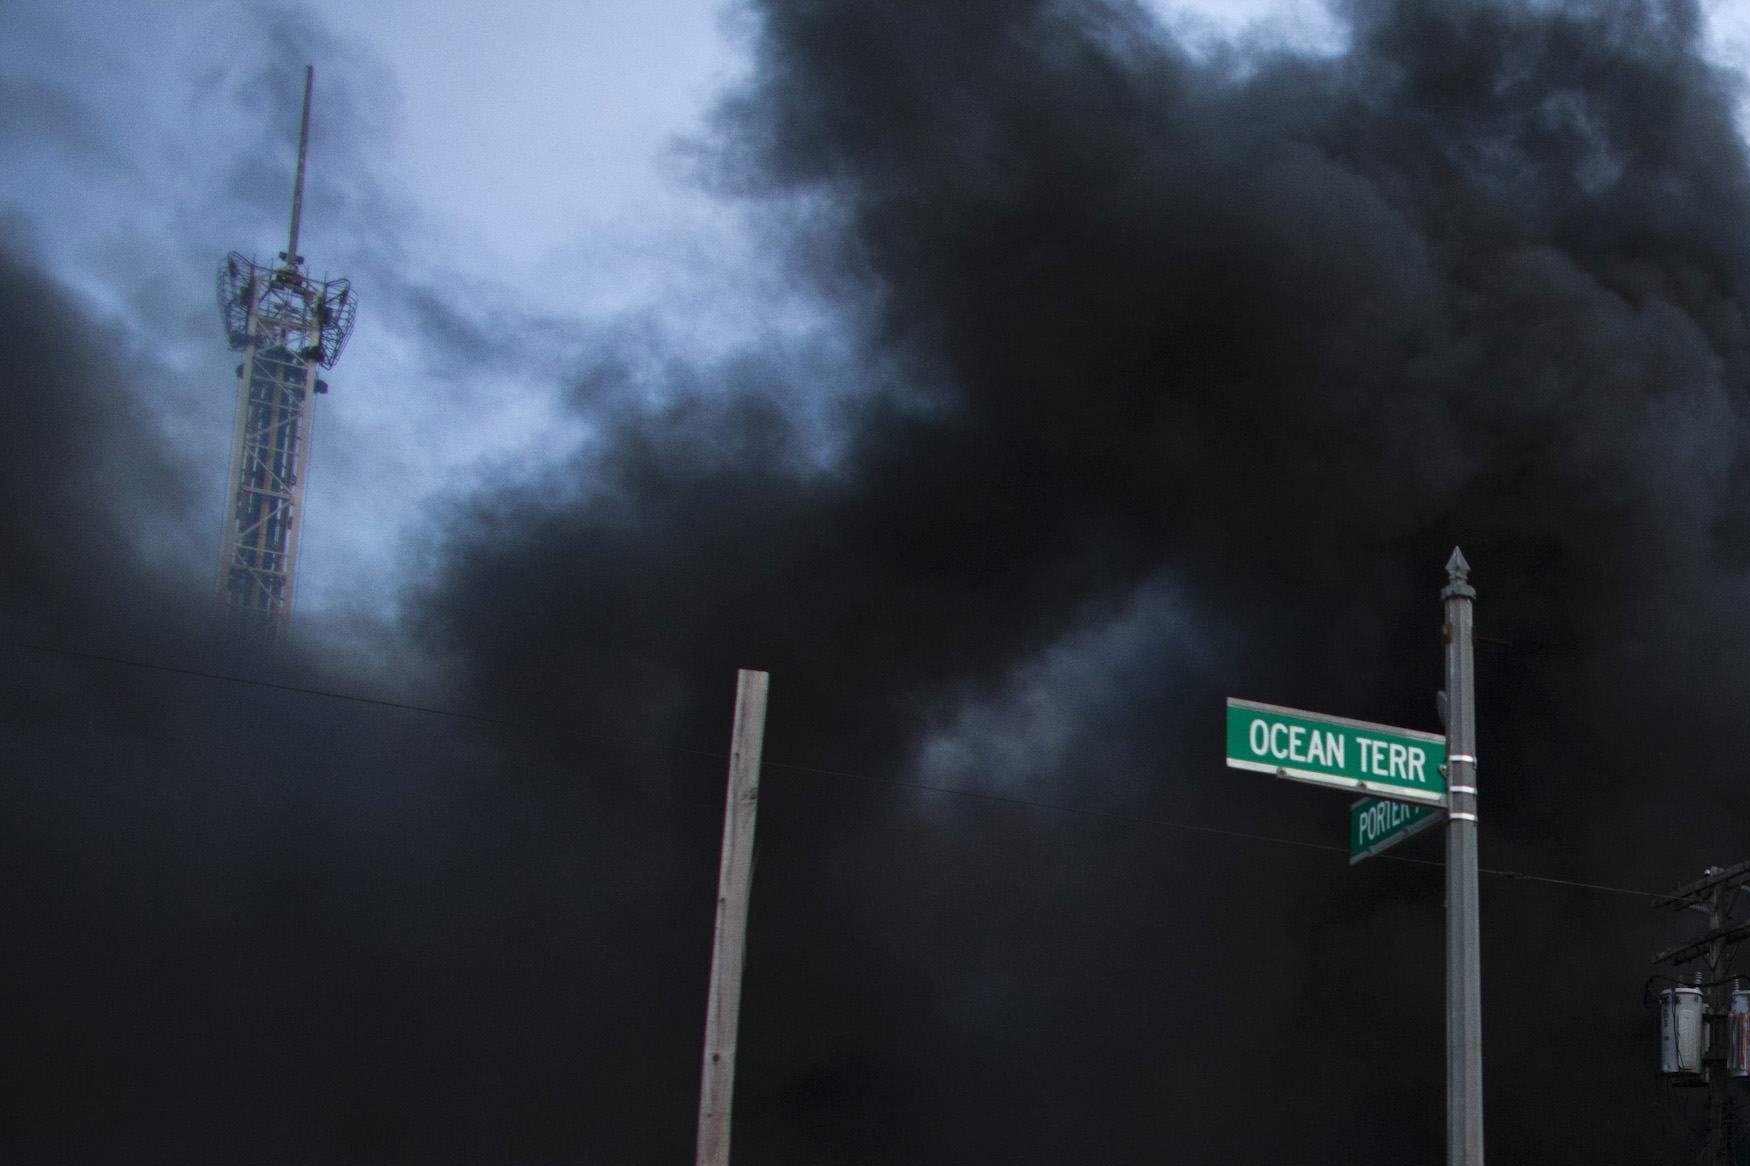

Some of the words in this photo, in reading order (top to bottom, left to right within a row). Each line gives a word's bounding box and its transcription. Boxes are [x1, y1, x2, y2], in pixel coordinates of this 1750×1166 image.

[1250, 719, 1345, 769] OCEAN
[1356, 737, 1426, 782] TERR
[1359, 801, 1410, 846] PORTER
